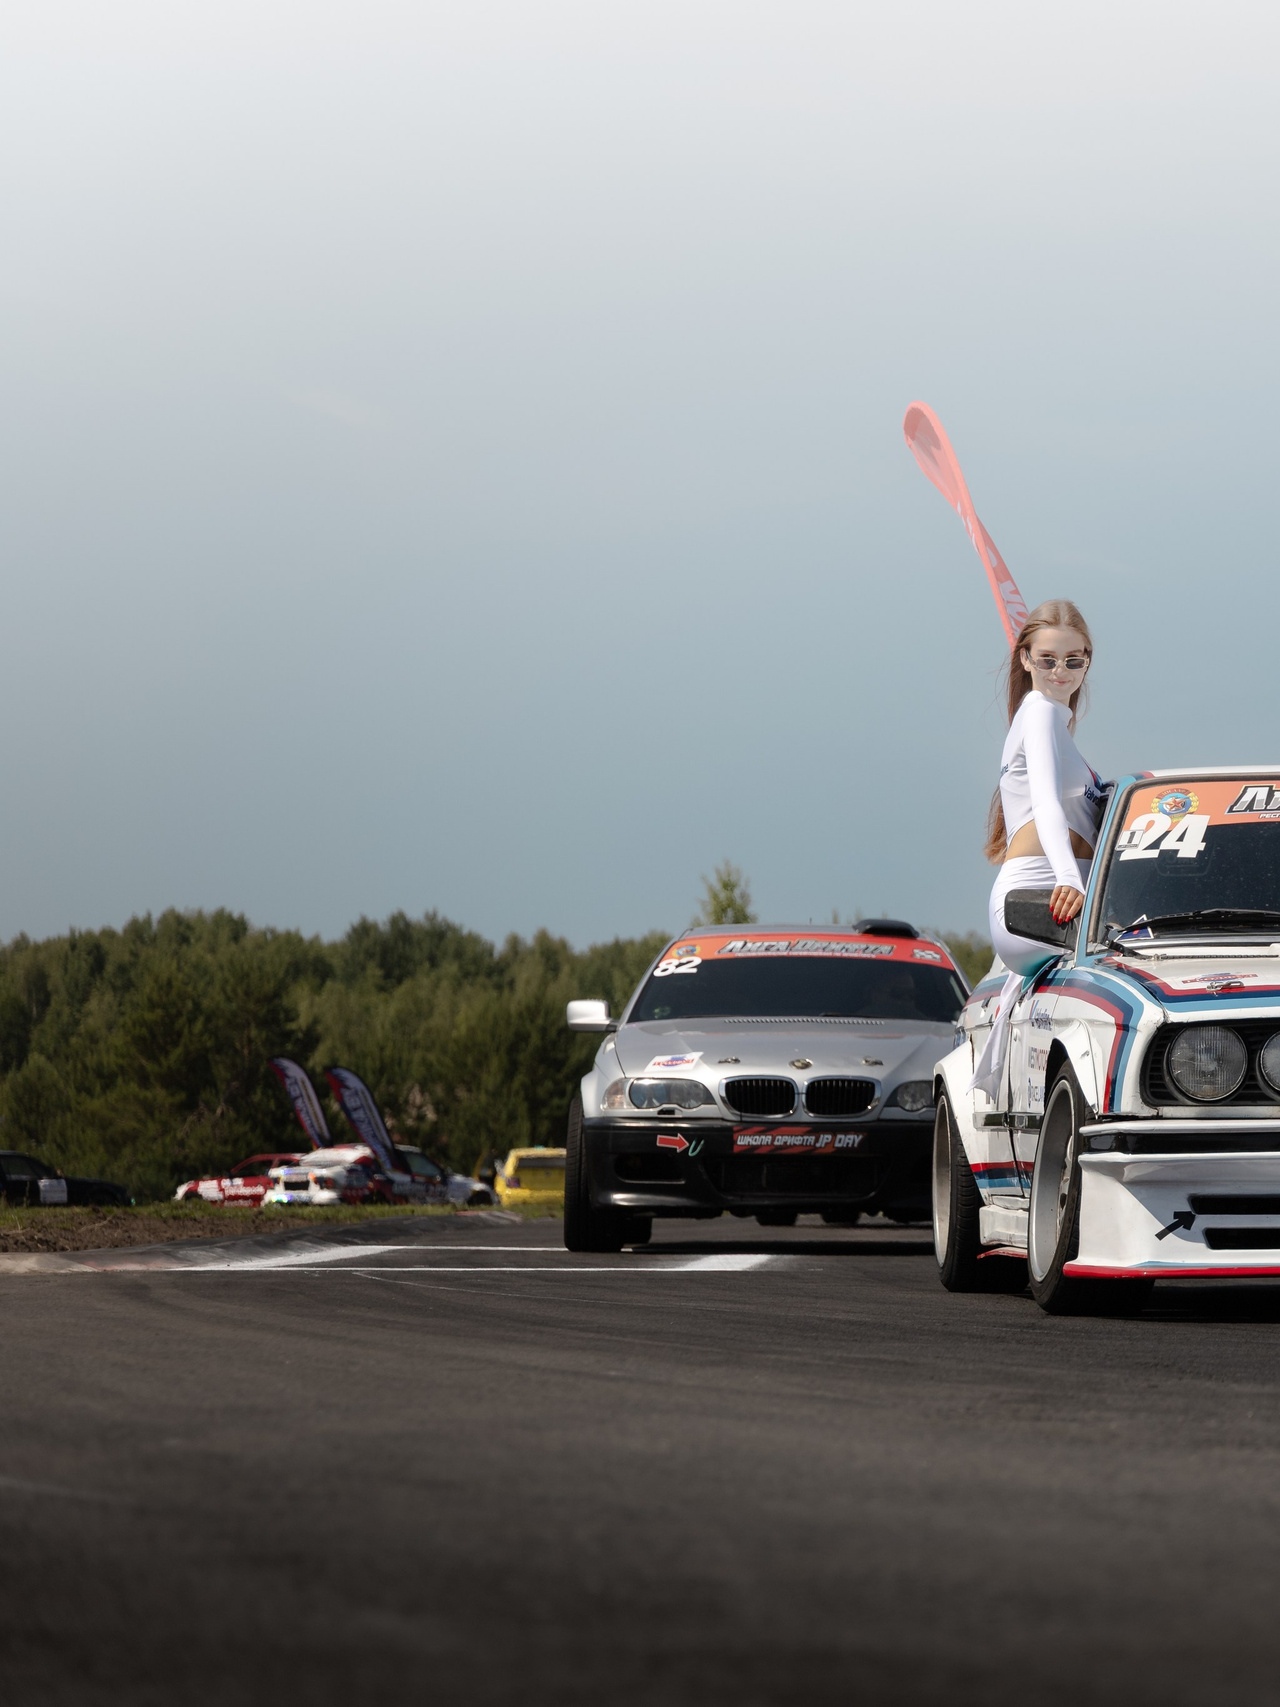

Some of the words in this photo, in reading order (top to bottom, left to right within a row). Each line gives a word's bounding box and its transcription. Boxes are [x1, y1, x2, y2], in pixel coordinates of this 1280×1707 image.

[1119, 813, 1210, 861] 24
[653, 956, 702, 977] 82
[736, 1134, 771, 1146] ШКОЛА
[773, 1134, 815, 1146] ДРИФТА
[815, 1133, 832, 1148] JP
[834, 1133, 864, 1148] DAY
